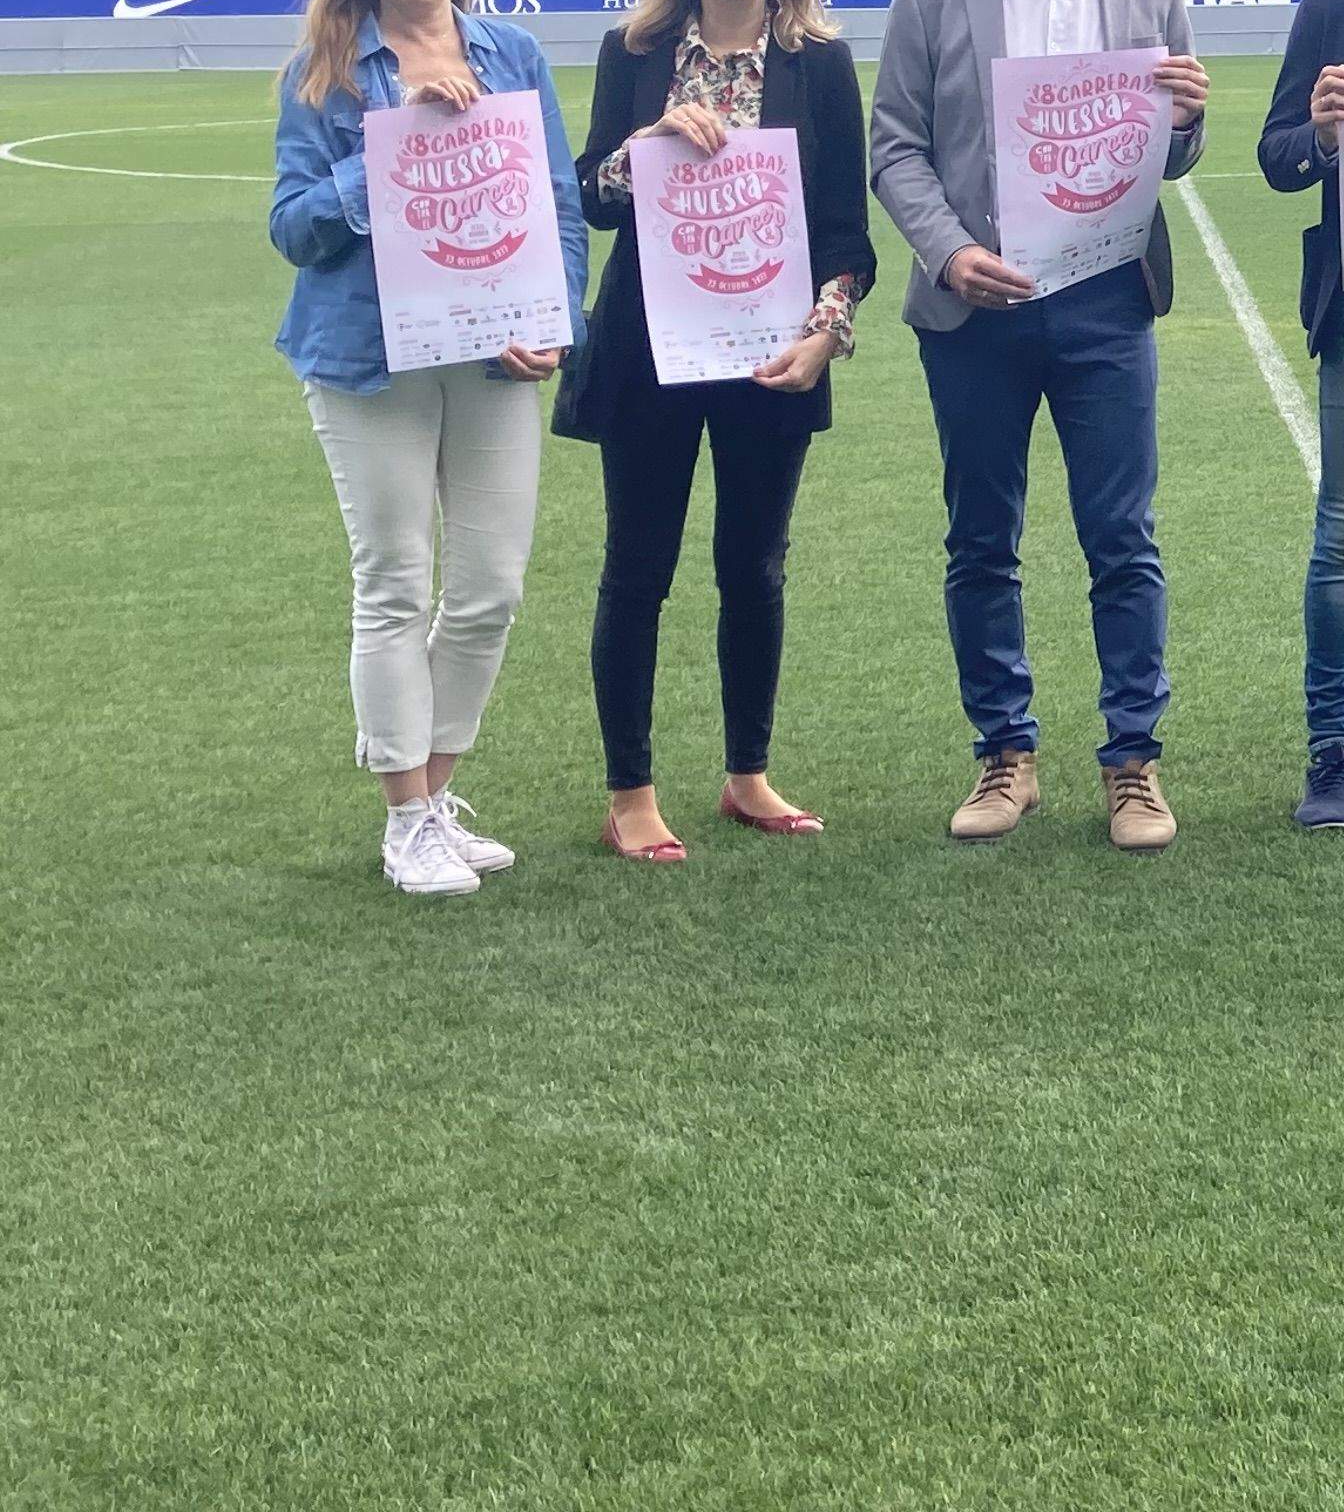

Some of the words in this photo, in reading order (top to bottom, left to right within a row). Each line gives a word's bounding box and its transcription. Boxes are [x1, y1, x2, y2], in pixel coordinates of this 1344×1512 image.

[1057, 73, 1142, 104] CARRERA
[432, 119, 518, 152] CARRERA
[699, 152, 781, 183] CARRERA
